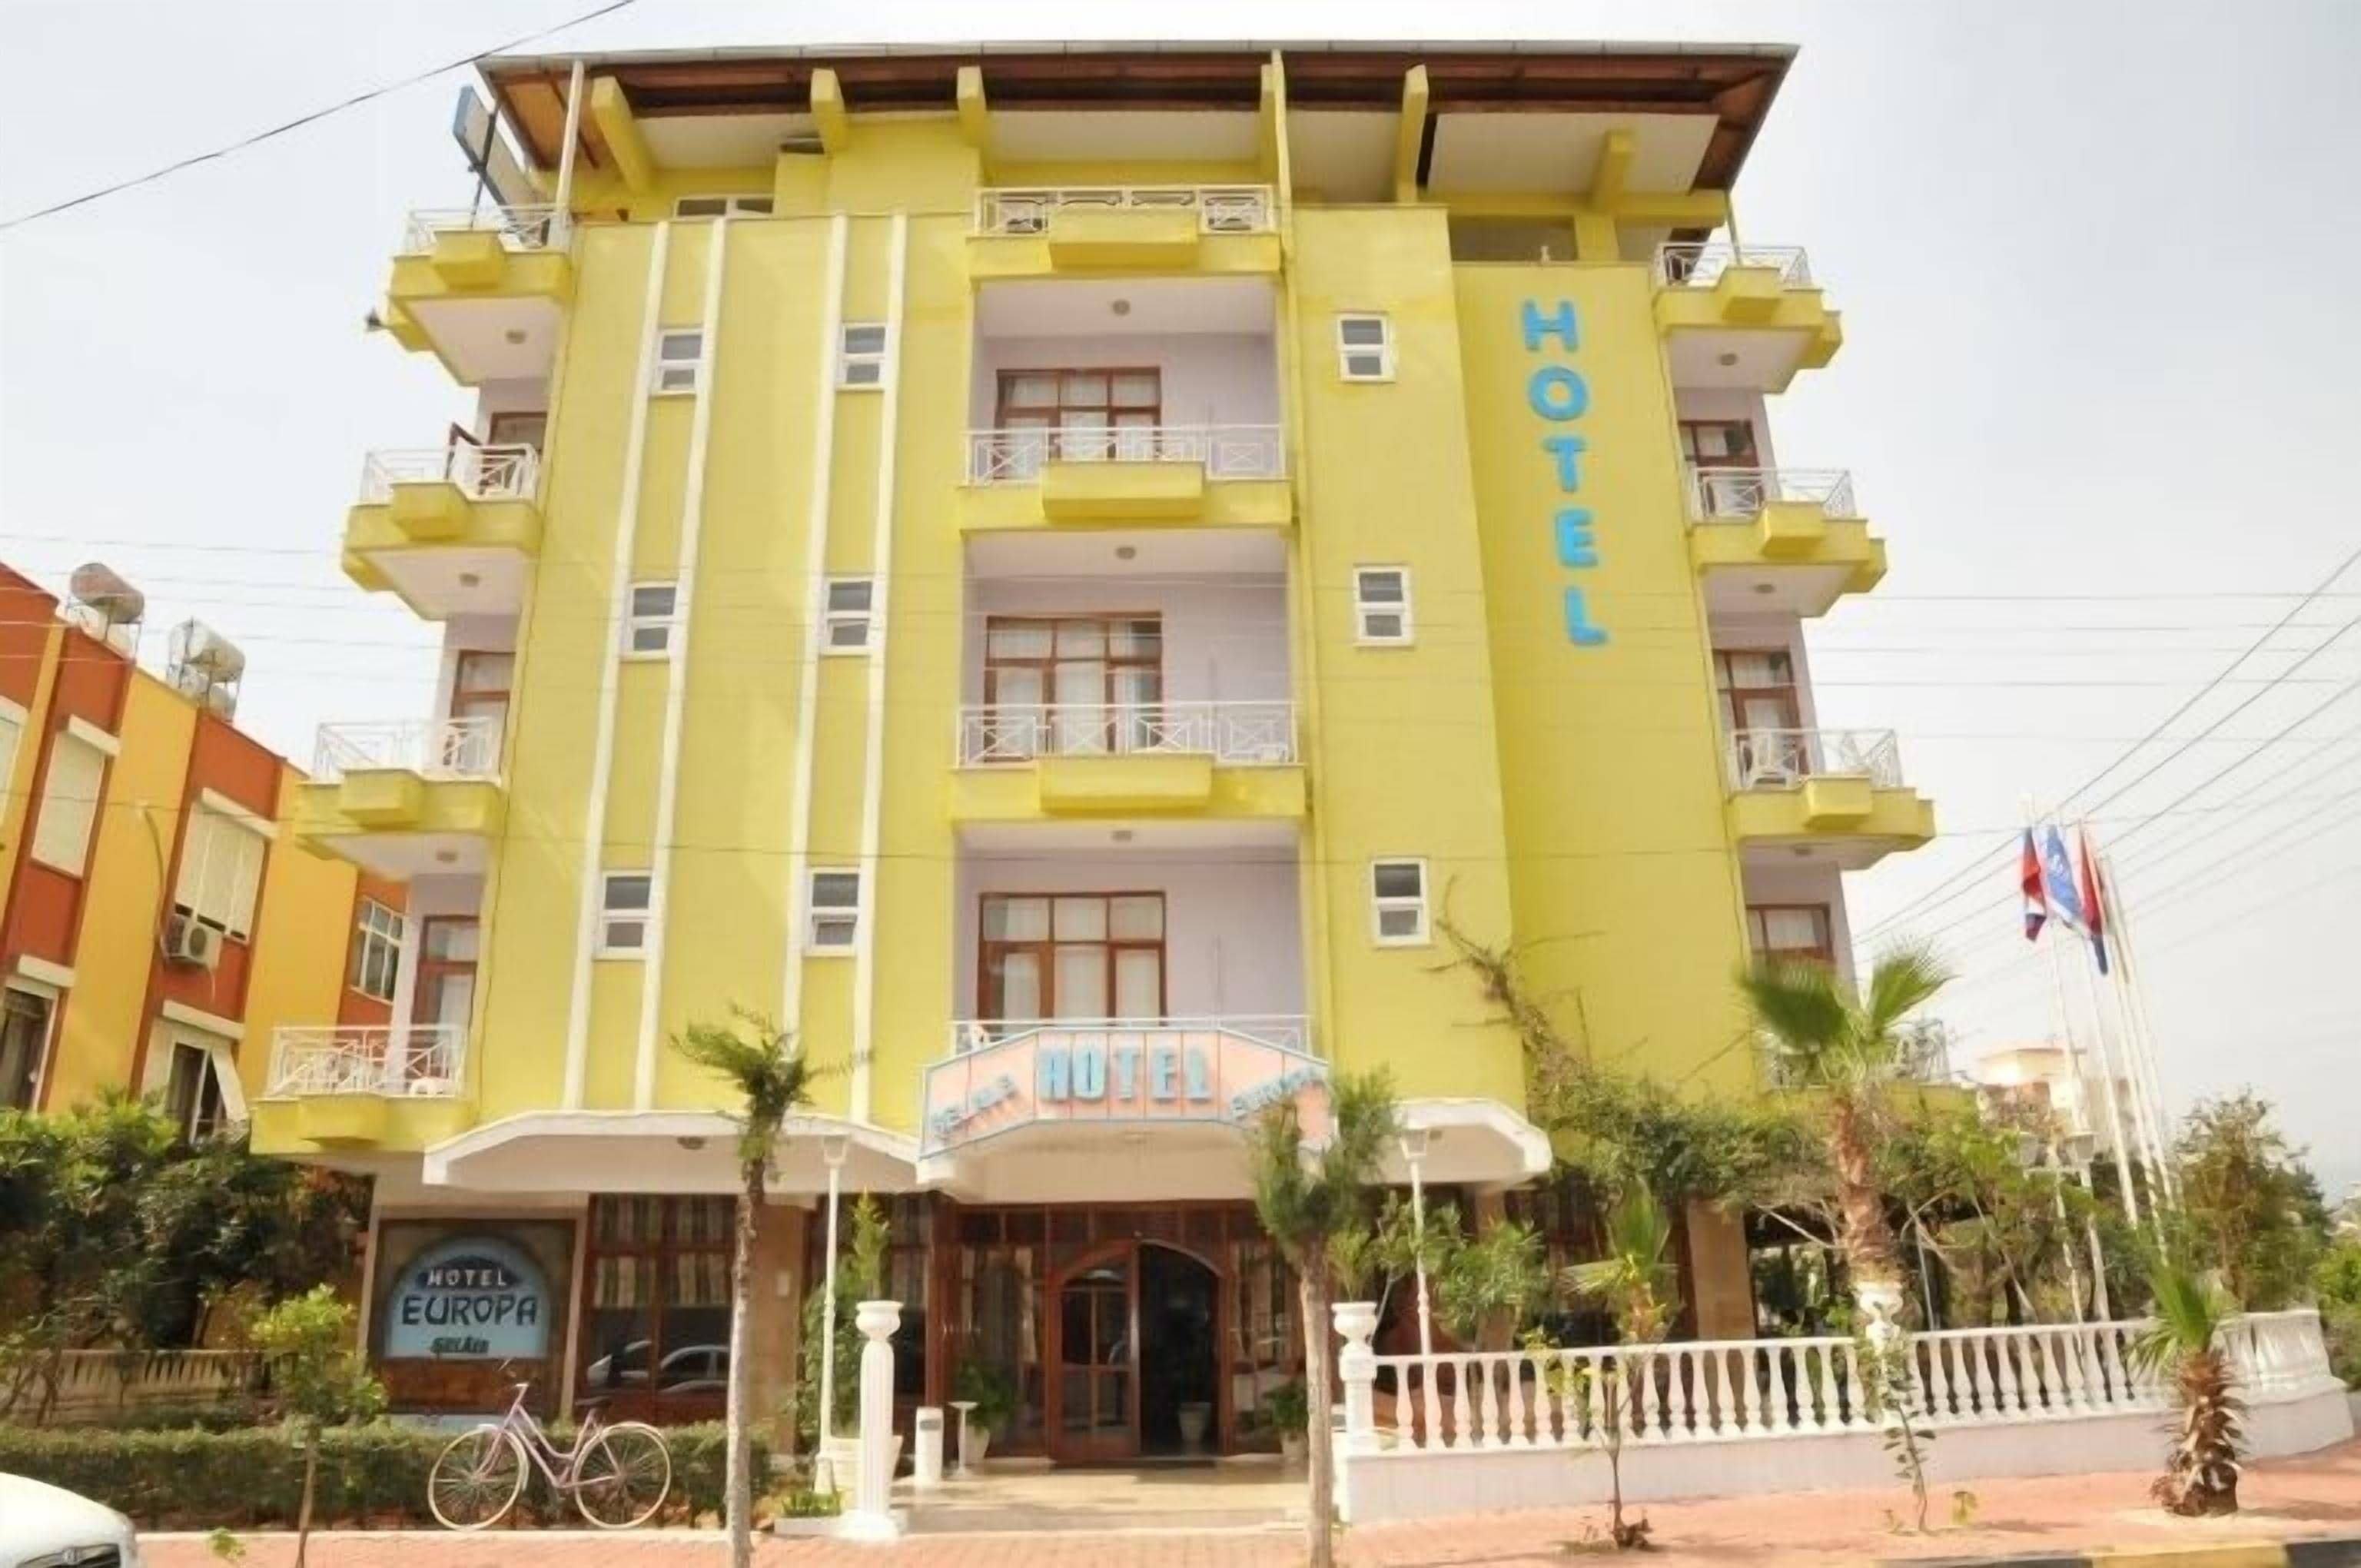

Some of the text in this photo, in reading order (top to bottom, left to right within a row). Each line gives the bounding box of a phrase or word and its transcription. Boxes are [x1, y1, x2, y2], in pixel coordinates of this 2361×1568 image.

[1522, 299, 1609, 647] HOTEL
[1038, 1046, 1213, 1101] HOTEL
[427, 1269, 507, 1286] HOTEL
[401, 1295, 538, 1325] EUROPA
